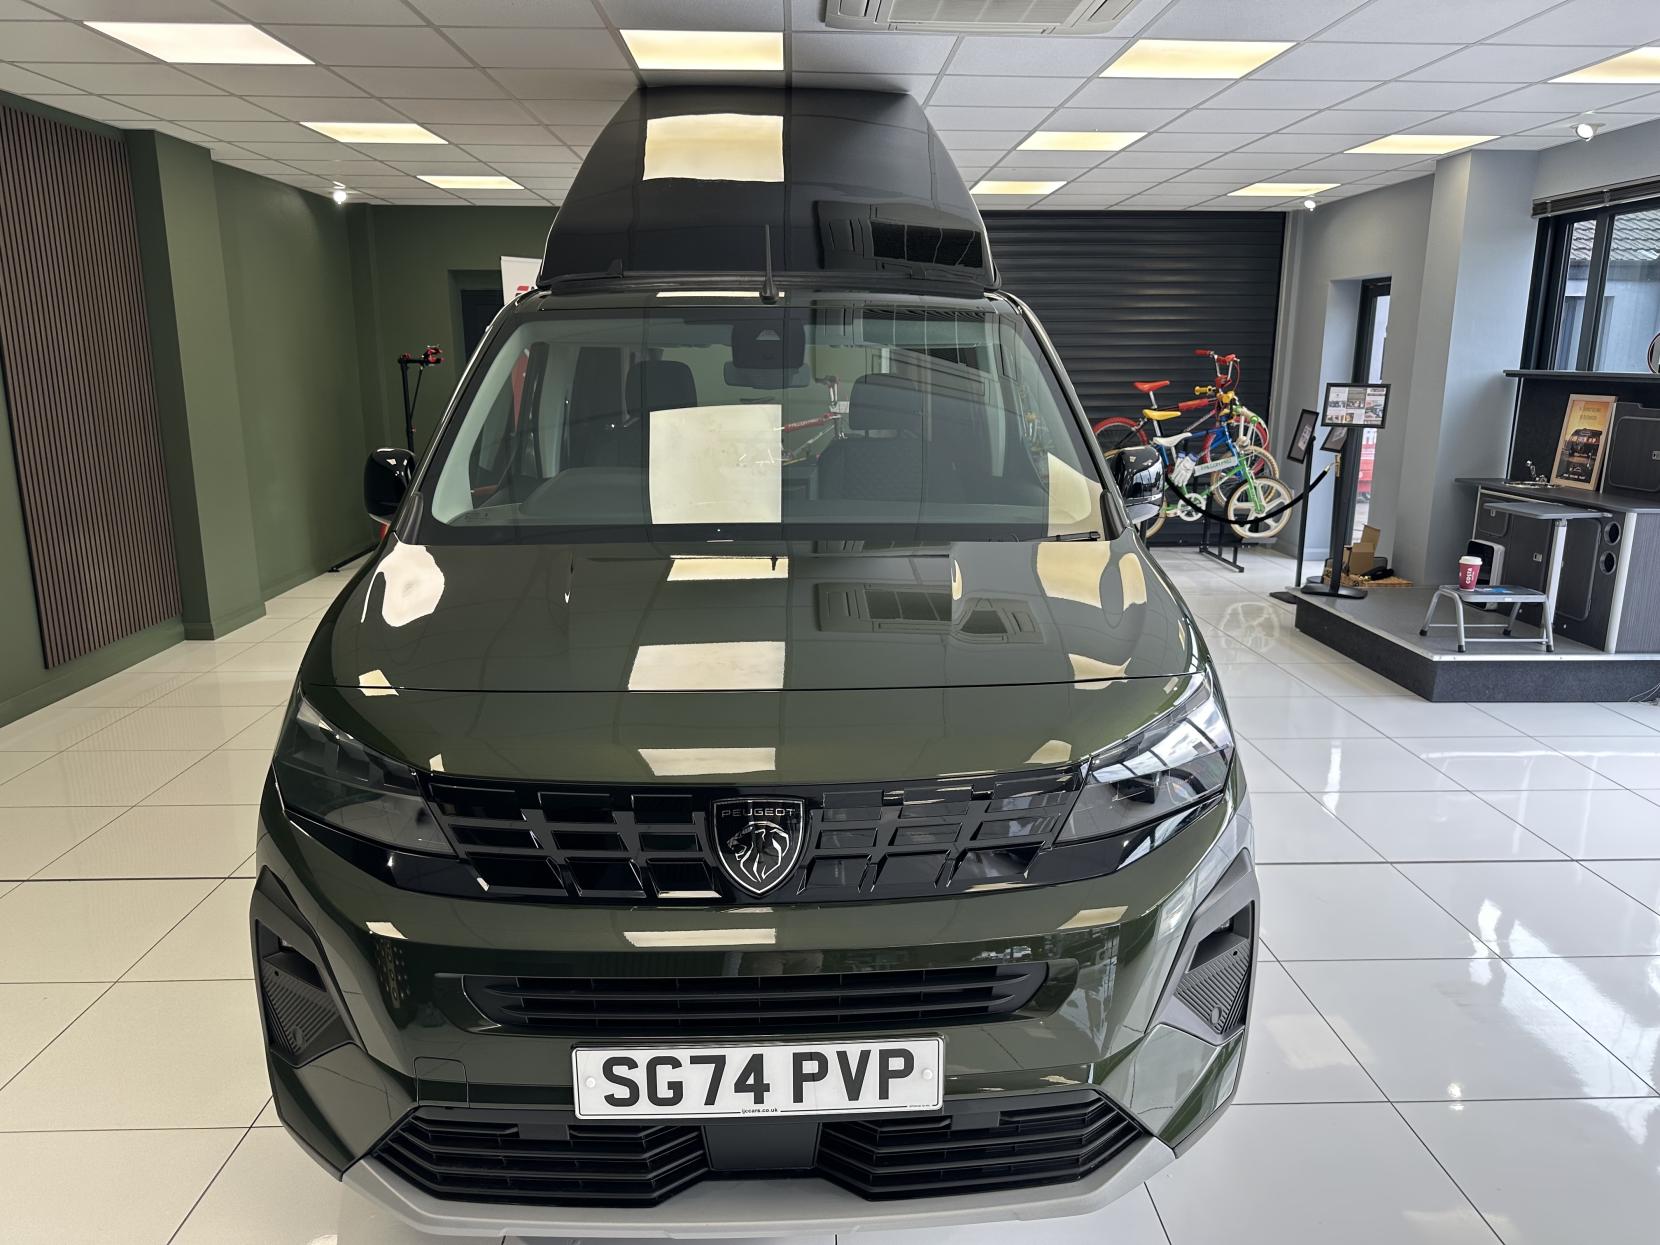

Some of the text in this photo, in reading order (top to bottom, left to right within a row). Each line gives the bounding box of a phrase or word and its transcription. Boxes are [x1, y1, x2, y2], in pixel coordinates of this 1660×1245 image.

[721, 808, 795, 817] PEUGEOT
[602, 1048, 915, 1107] SG74 PVP
